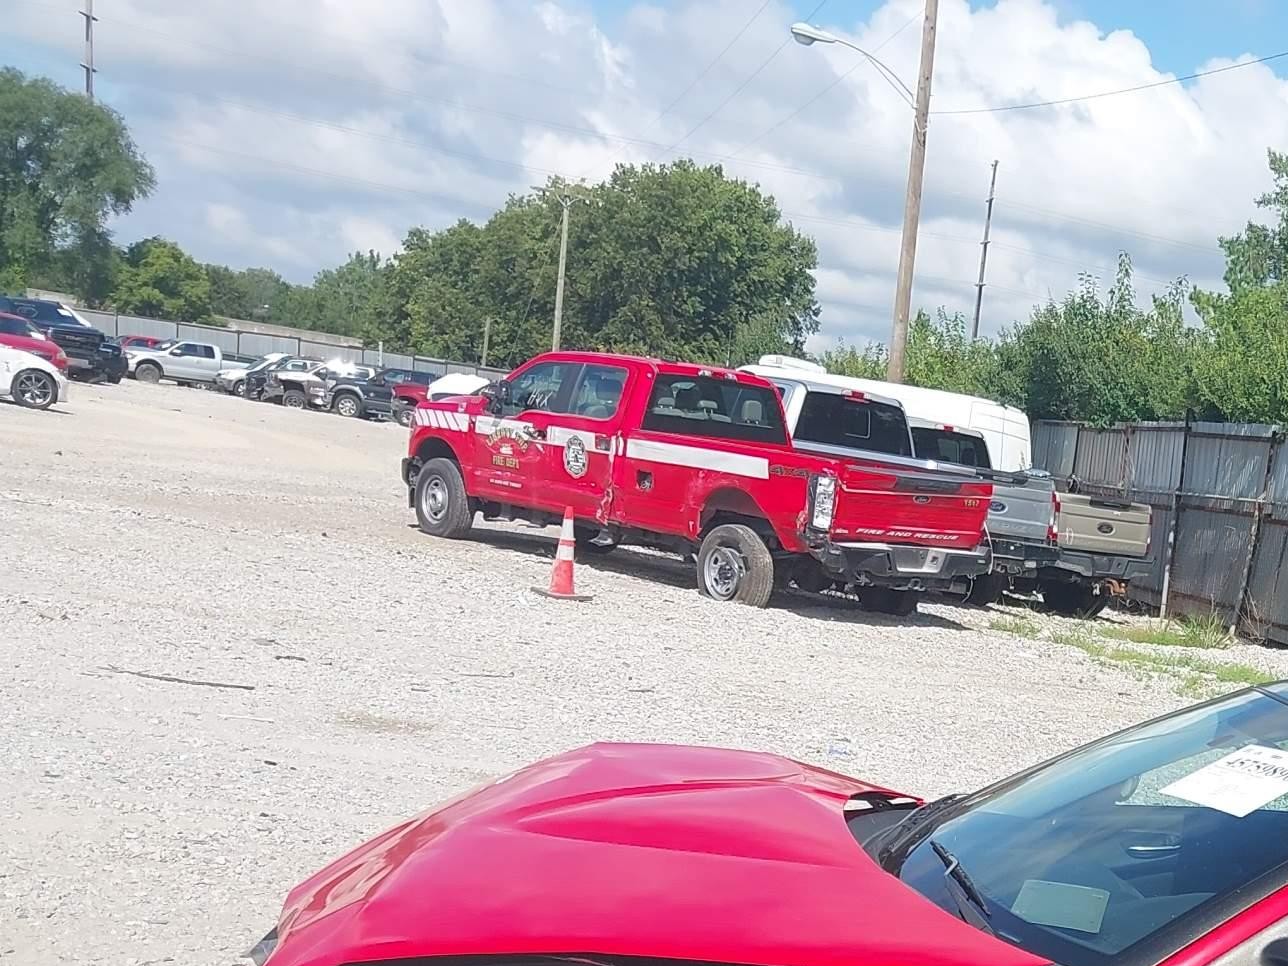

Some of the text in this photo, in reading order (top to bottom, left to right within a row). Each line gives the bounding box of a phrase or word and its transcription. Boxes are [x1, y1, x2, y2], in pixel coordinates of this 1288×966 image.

[492, 455, 505, 466] FIRE
[855, 527, 886, 536] FIRE
[886, 530, 913, 539] AND
[913, 532, 960, 541] RESCUE
